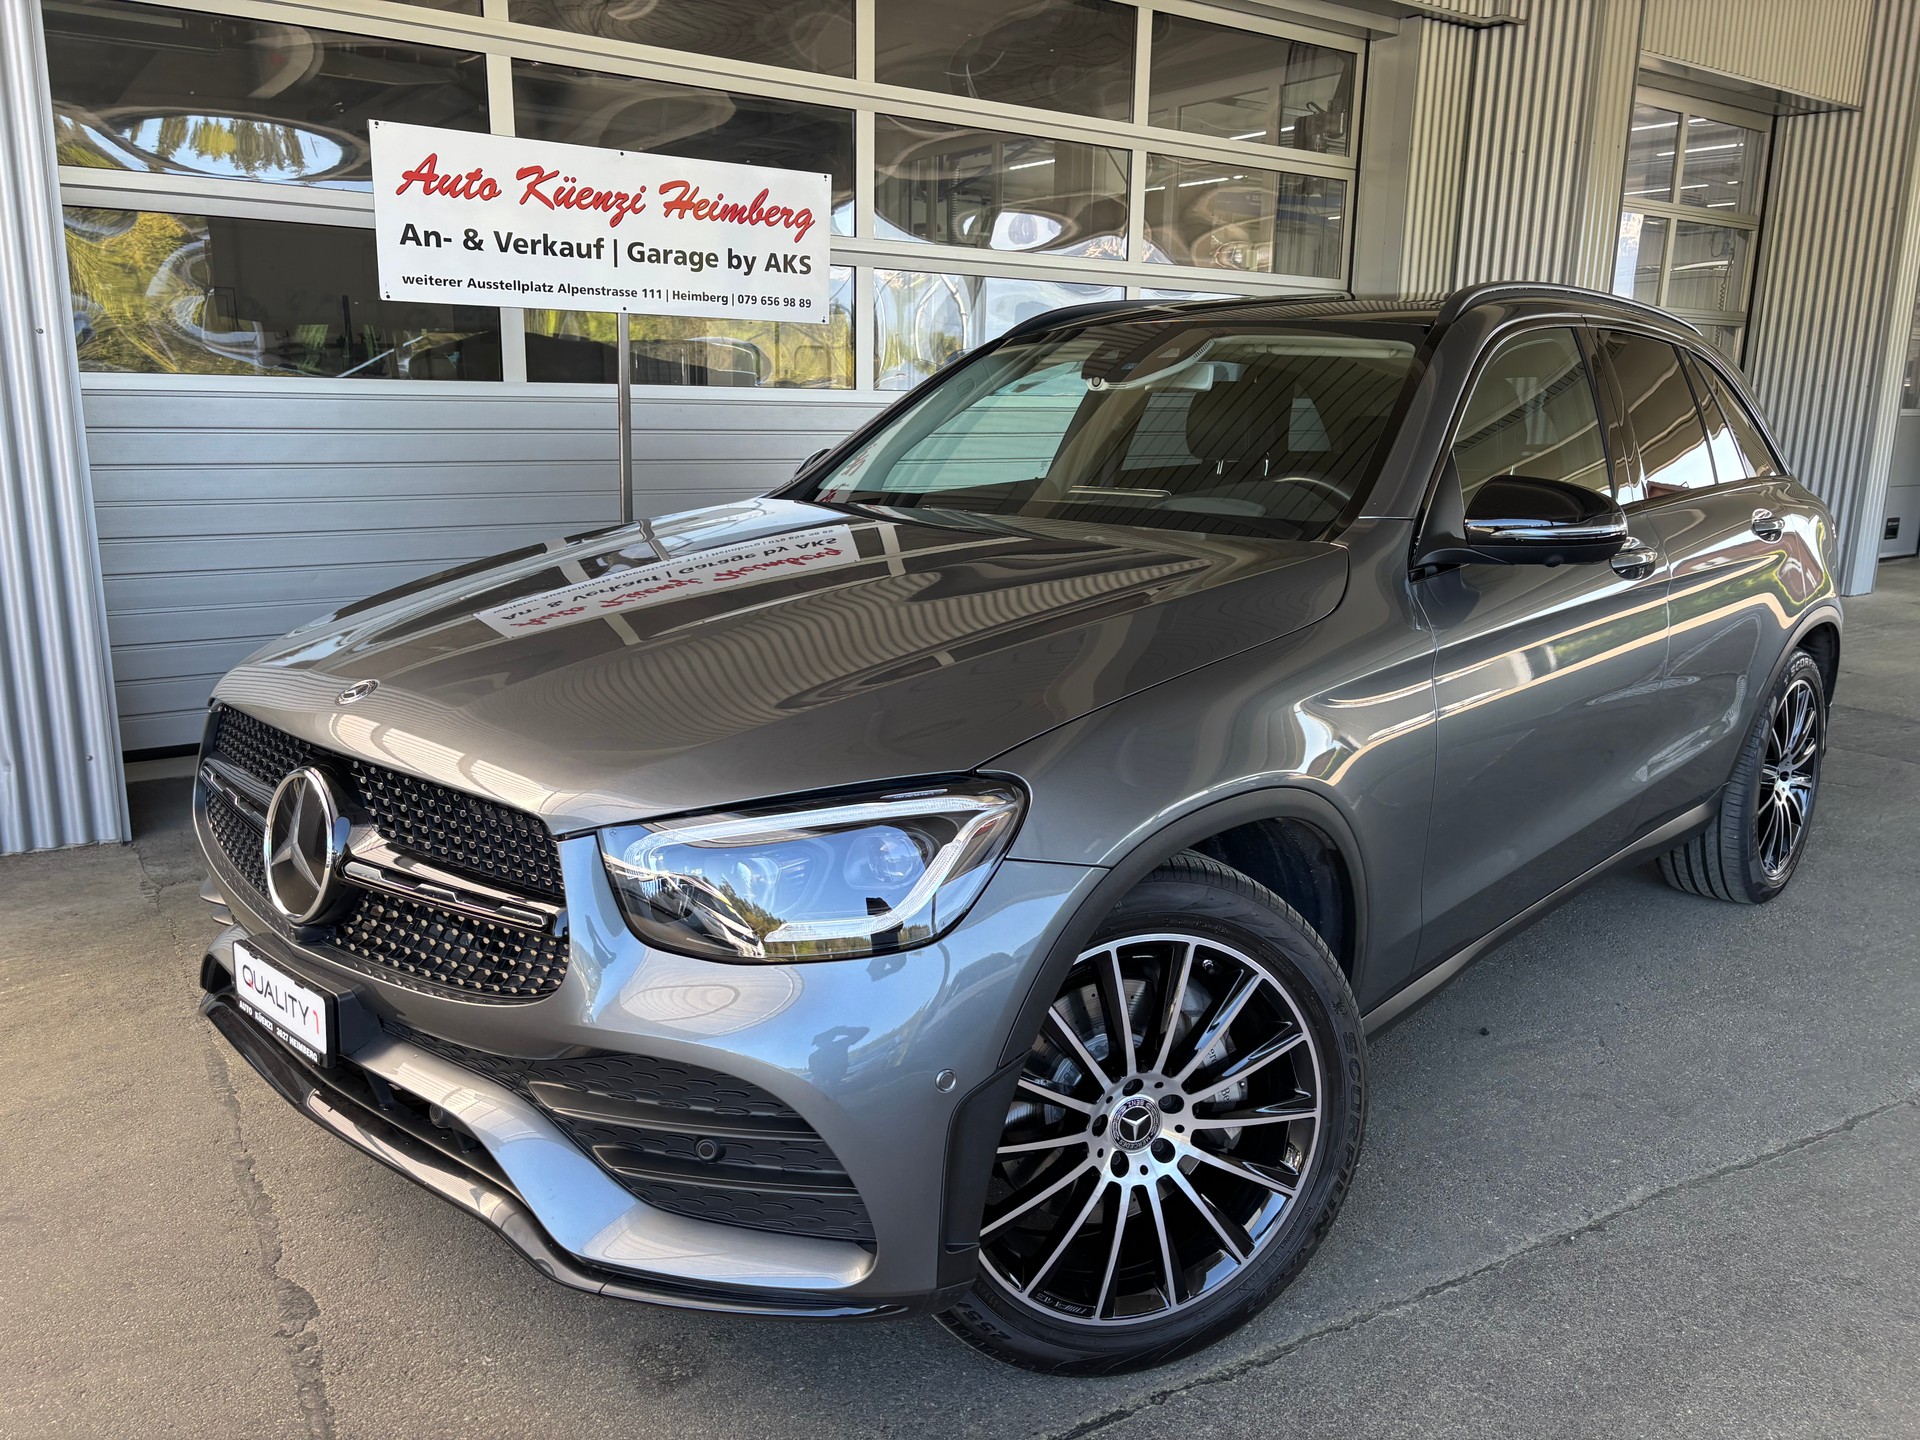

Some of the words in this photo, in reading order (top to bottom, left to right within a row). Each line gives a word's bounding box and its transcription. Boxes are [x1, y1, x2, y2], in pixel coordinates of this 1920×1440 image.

[395, 152, 502, 201] Auto
[516, 165, 647, 228] Küenzi
[658, 180, 816, 243] Heimberg
[399, 223, 452, 248] An-
[462, 228, 485, 252] &
[493, 231, 605, 260] Verkauf
[627, 242, 719, 272] Garage
[727, 248, 757, 276] by
[764, 253, 812, 275] AKS
[401, 274, 463, 288] weiterer
[467, 277, 554, 294] Ausstellplatz
[557, 283, 638, 298] Alpenstrasse
[641, 288, 662, 299] 111
[672, 290, 729, 306] Heimberg
[737, 294, 757, 305] 079
[760, 296, 780, 306] 656
[783, 297, 796, 308] 98
[798, 298, 812, 309] 89
[239, 1000, 253, 1016] AUTO
[254, 1010, 273, 1032] KÜENZI
[289, 1035, 318, 1063] HEIMBERG
